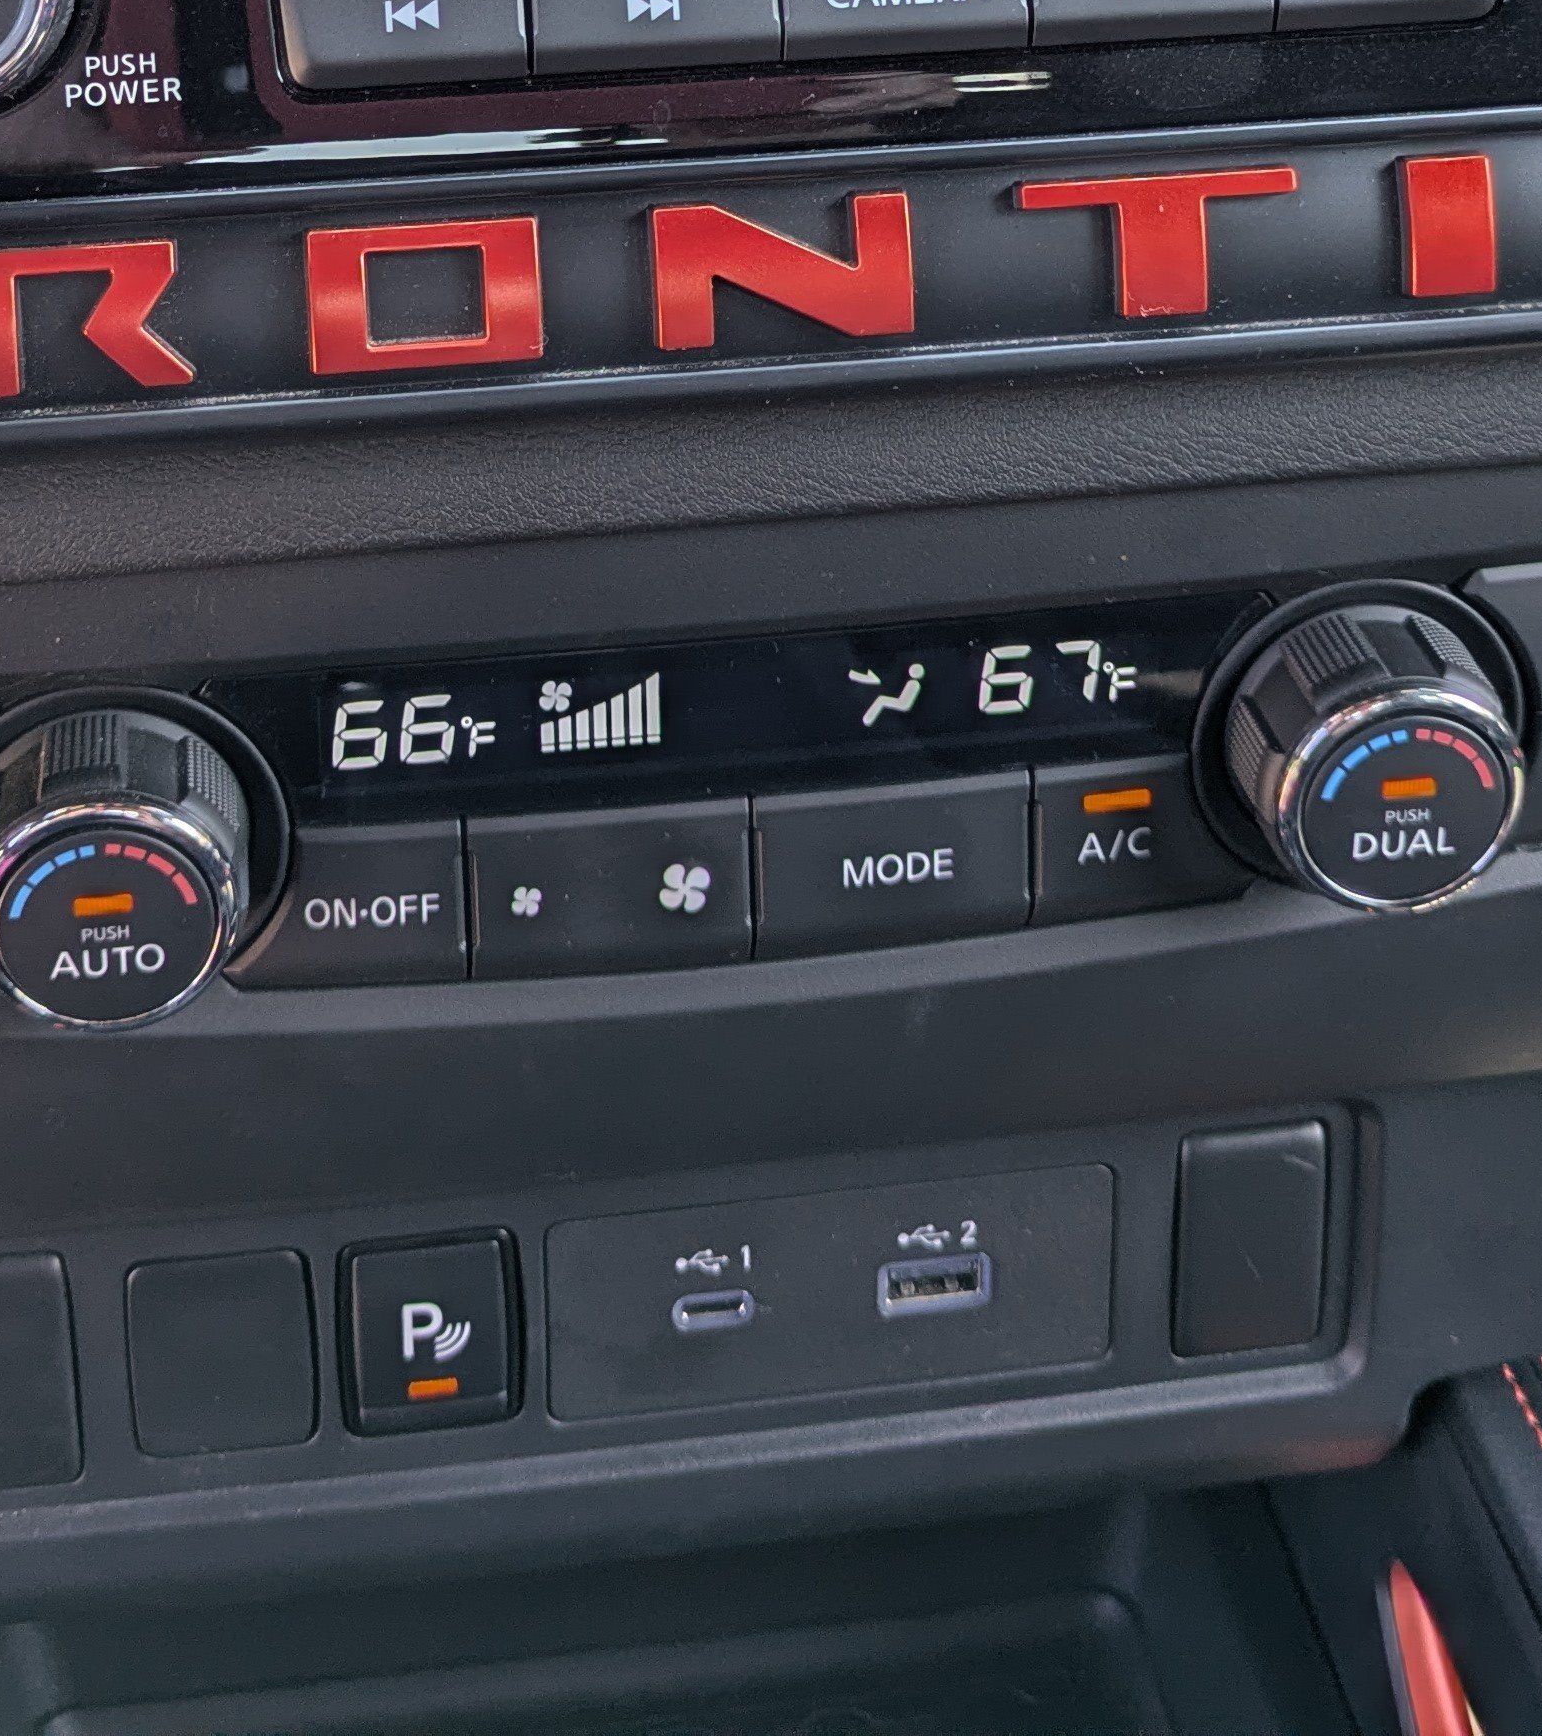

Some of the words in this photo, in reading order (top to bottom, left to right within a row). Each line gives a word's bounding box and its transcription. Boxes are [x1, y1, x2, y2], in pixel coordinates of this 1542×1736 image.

[84, 52, 157, 79] PUSH
[64, 77, 183, 108] POWER
[1384, 807, 1431, 825] PUSH
[1078, 826, 1152, 864] A/C
[1352, 826, 1456, 862] DUAL
[842, 847, 954, 889] MODE
[80, 924, 131, 943] PUSH
[49, 941, 167, 982] AUTO
[959, 1220, 978, 1248] 2
[739, 1244, 752, 1271] 1
